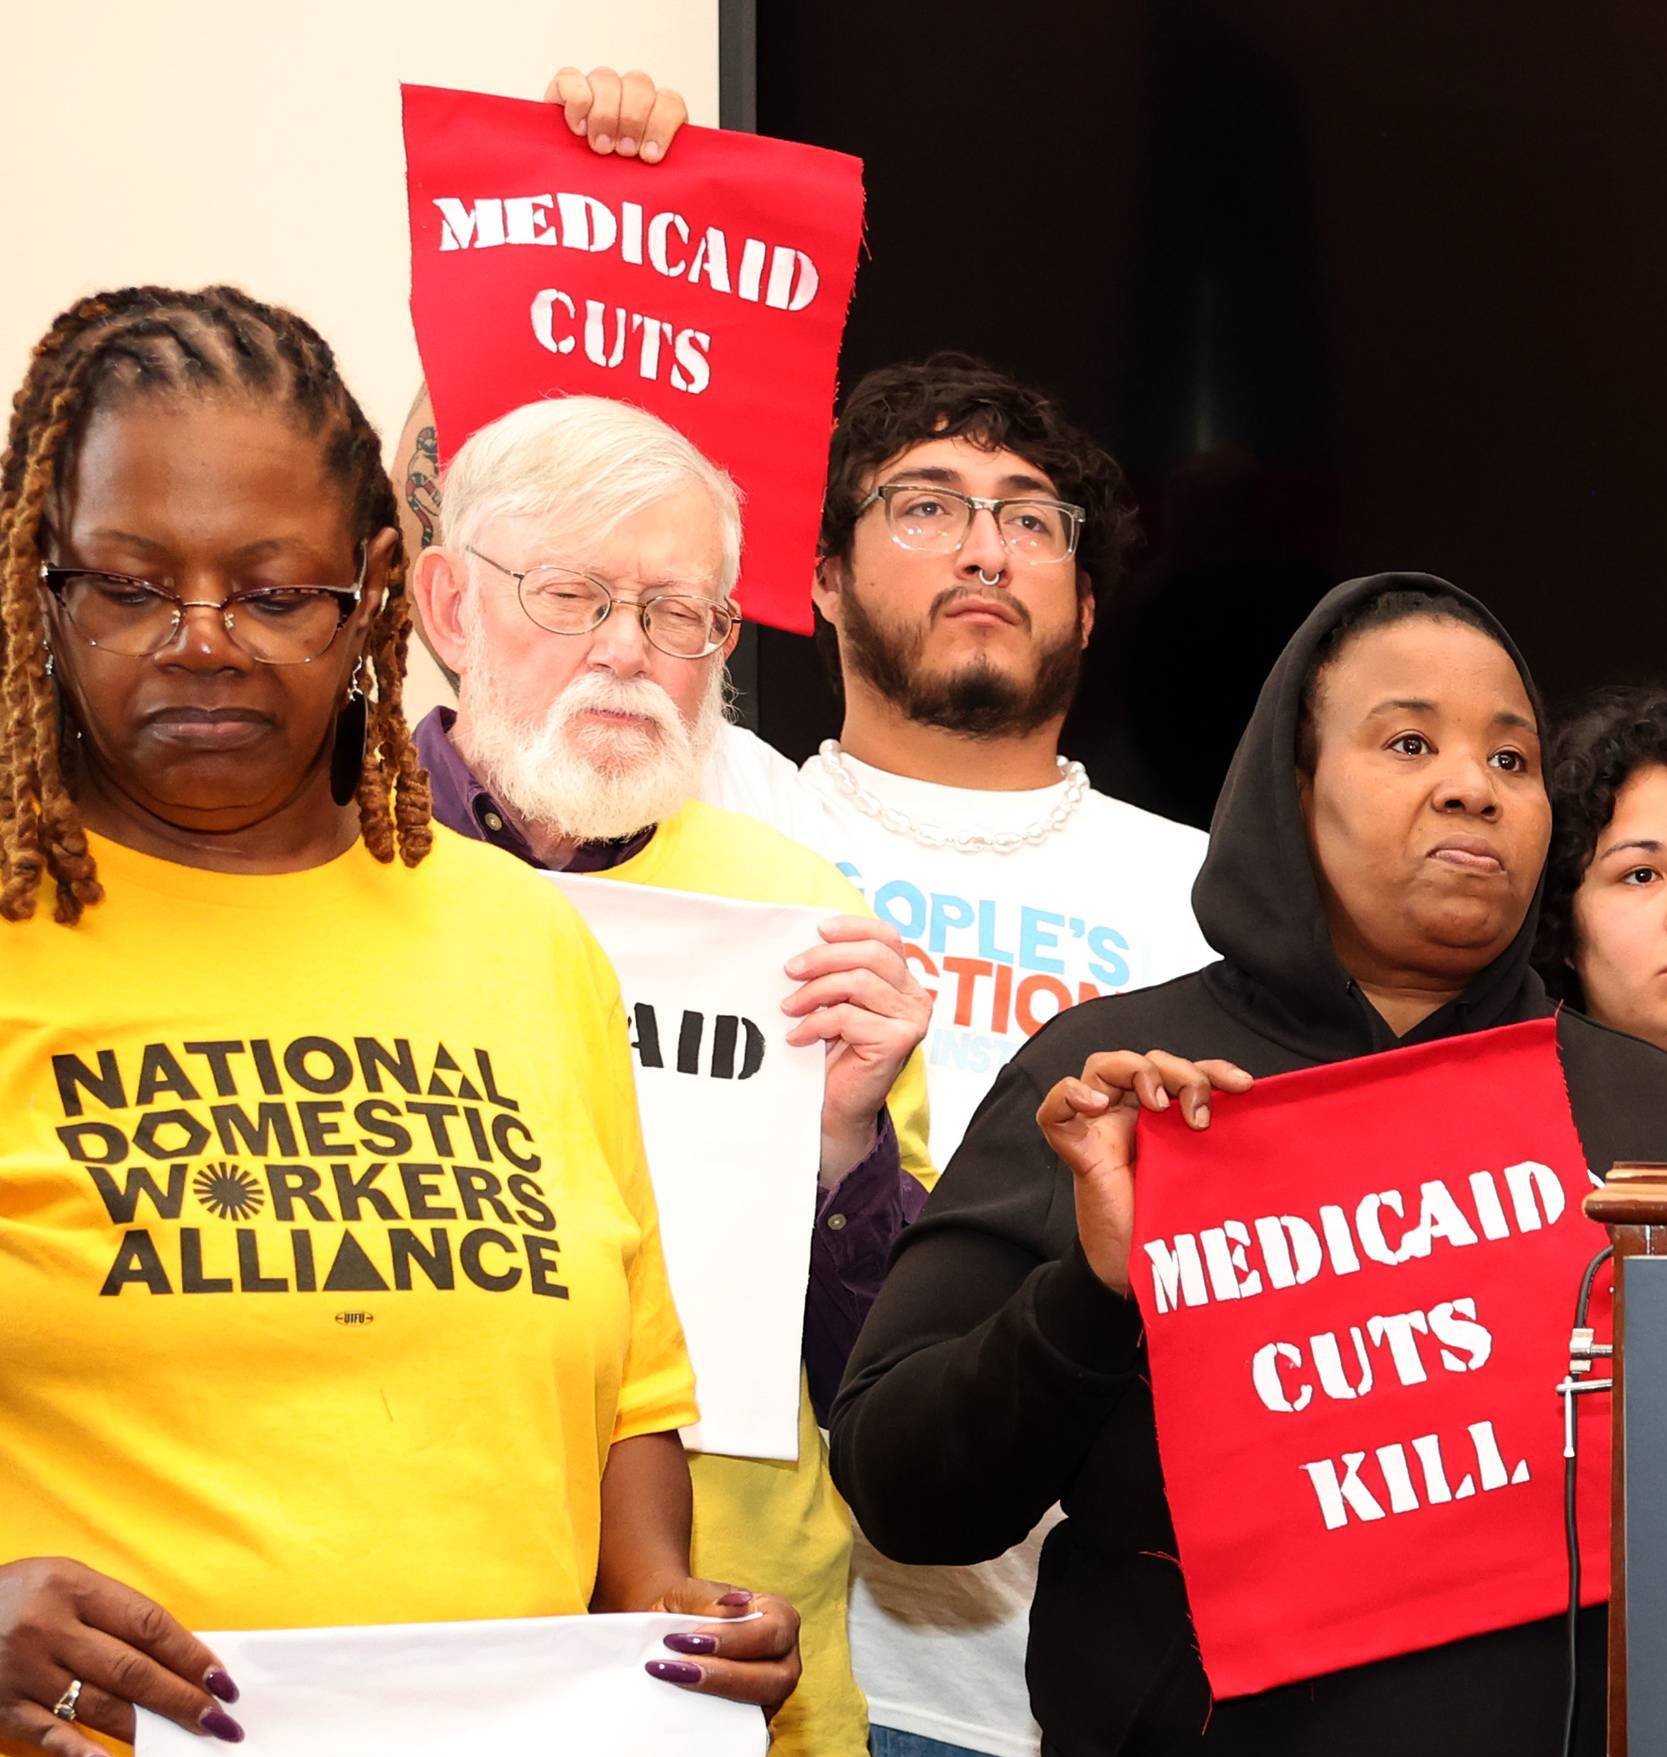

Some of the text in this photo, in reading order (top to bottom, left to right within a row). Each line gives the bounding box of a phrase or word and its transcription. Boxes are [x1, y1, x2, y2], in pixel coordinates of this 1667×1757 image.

[432, 193, 820, 311] MEDICAID
[530, 289, 712, 394] CUTS
[52, 1036, 519, 1116] NATIONAL
[55, 1100, 542, 1173] DOMESTIC
[84, 1162, 558, 1232] WORKERS
[1144, 1160, 1565, 1314] MEDICAID
[98, 1228, 569, 1300] ALLIANCE
[1251, 1297, 1493, 1412] CUTS
[1300, 1421, 1530, 1530] KILL
